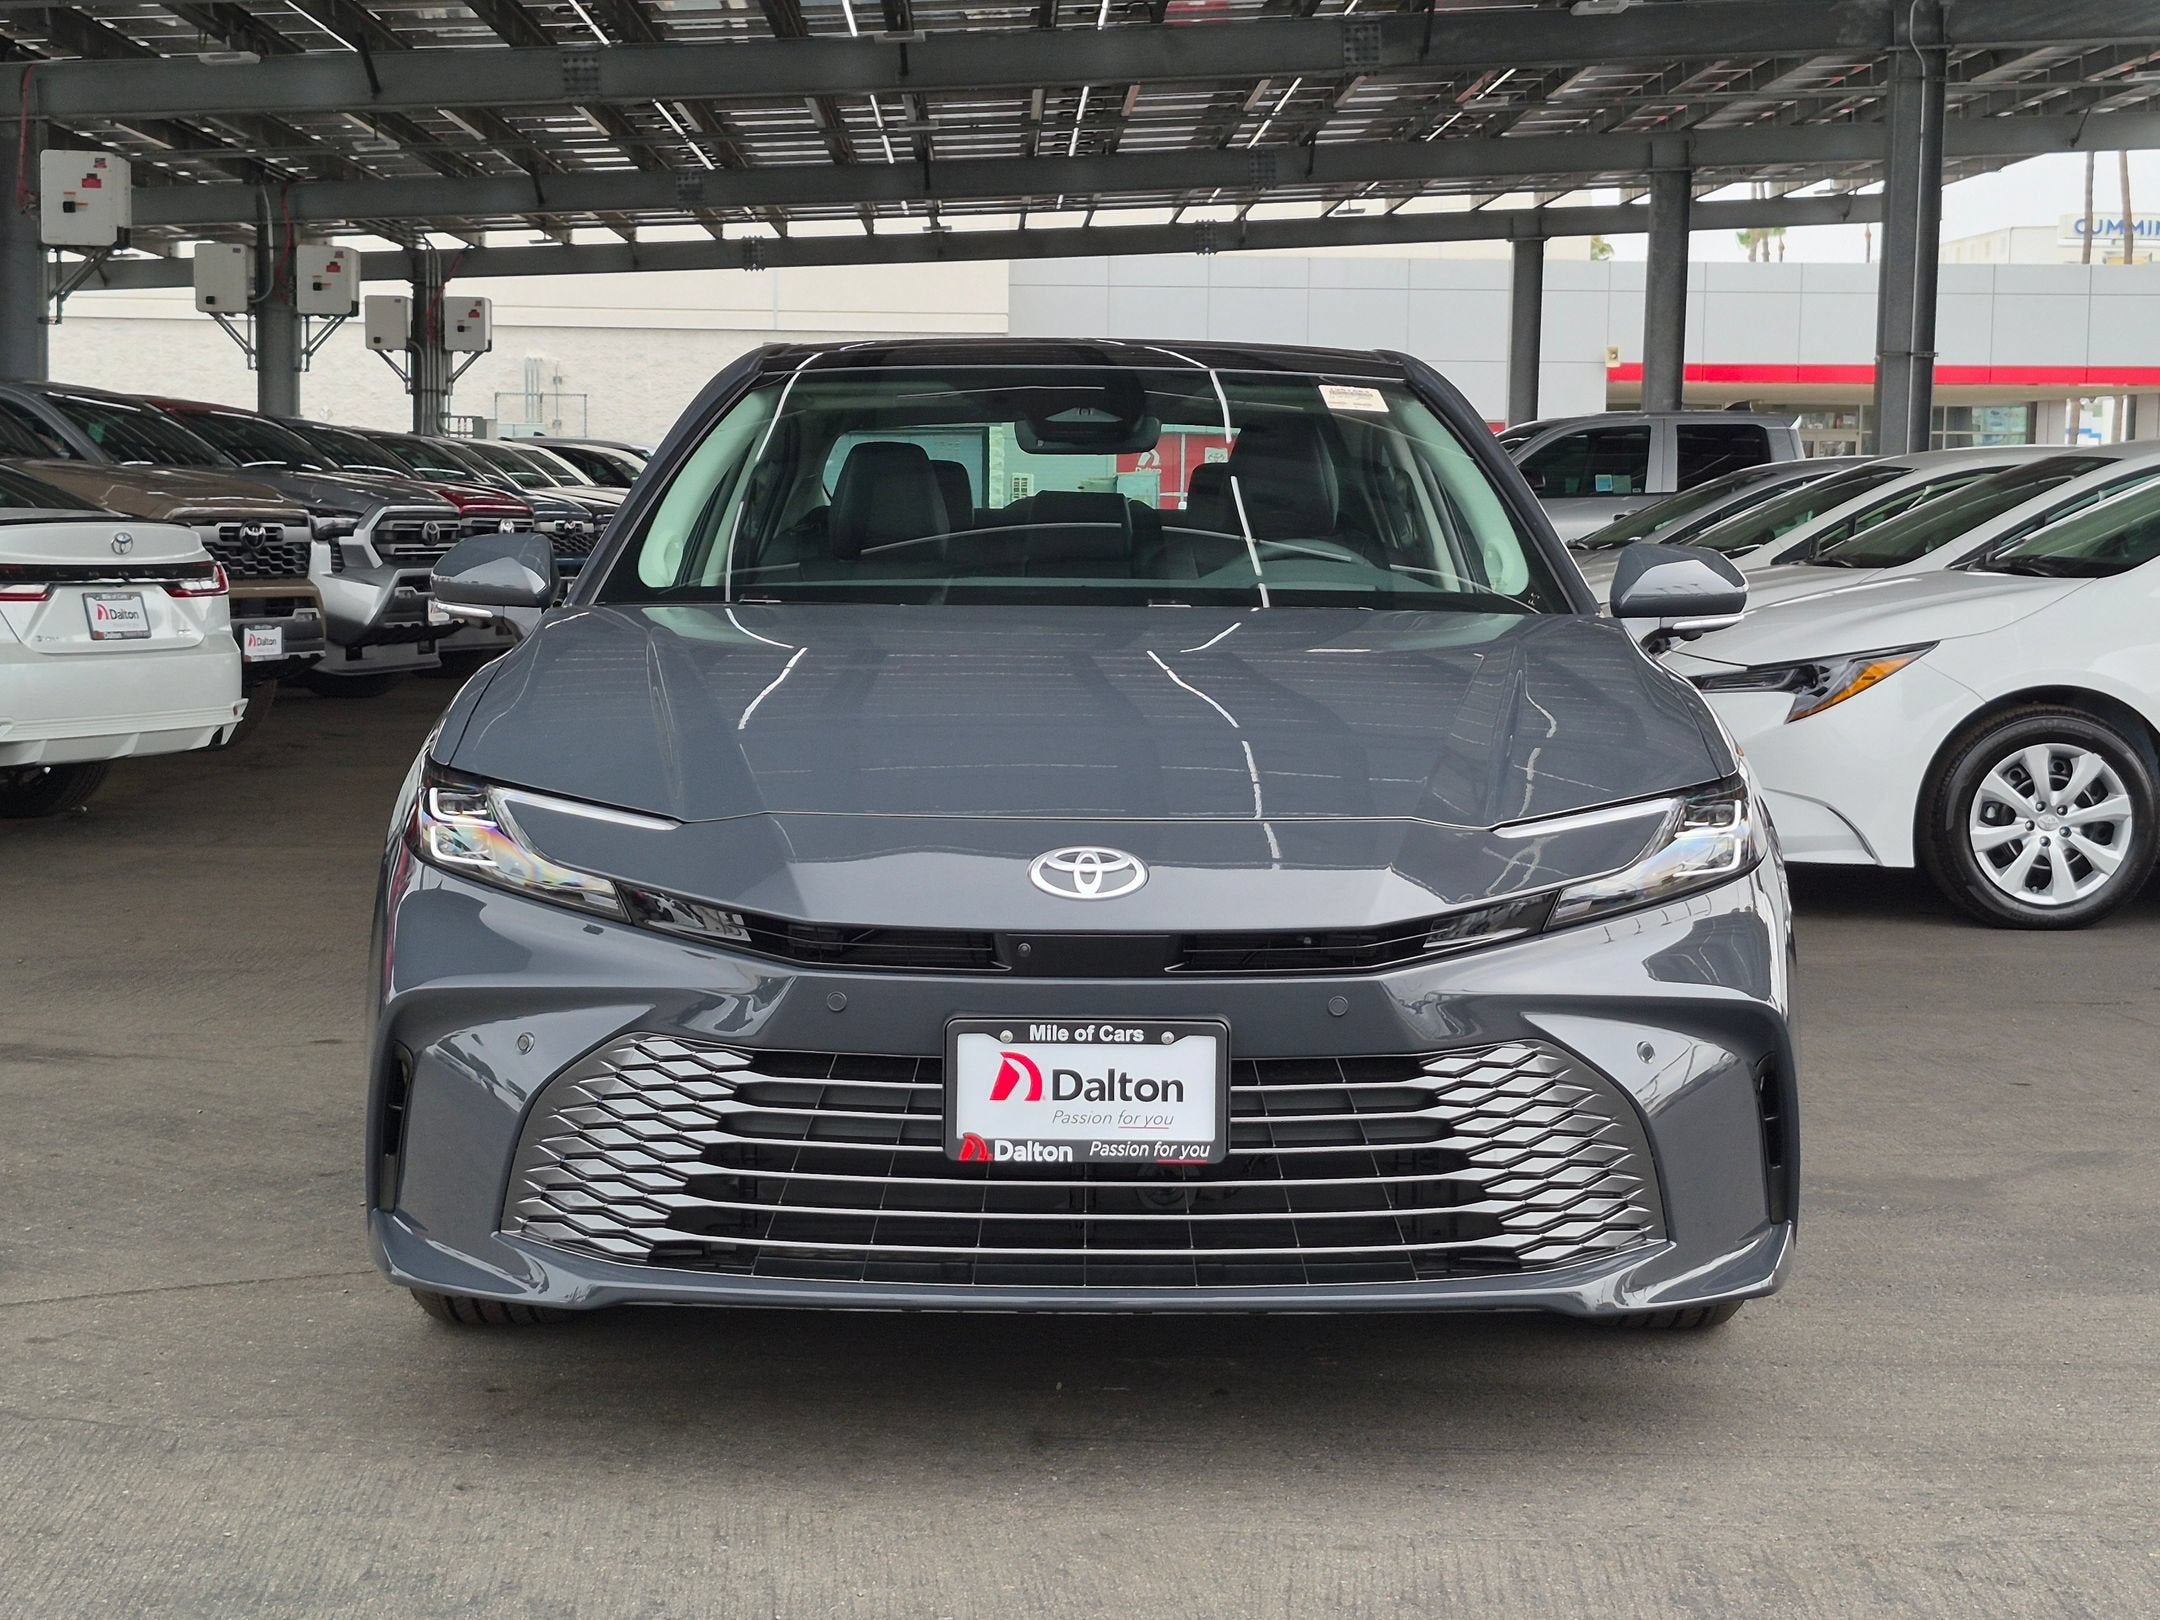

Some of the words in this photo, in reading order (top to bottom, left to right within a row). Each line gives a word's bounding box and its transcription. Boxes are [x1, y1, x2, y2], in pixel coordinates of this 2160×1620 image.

[109, 608, 140, 620] Dalton
[1029, 1024, 1071, 1042] Mile
[1075, 1025, 1096, 1042] of
[1099, 1026, 1145, 1042] Cars
[1052, 1068, 1184, 1103] Dalton
[1052, 1110, 1112, 1125] Passion
[1117, 1110, 1139, 1126] for
[1143, 1114, 1174, 1127] you
[994, 1140, 1073, 1162] Dalton
[1089, 1141, 1149, 1157] Passion
[1153, 1141, 1177, 1158] for
[1179, 1144, 1210, 1160] you
